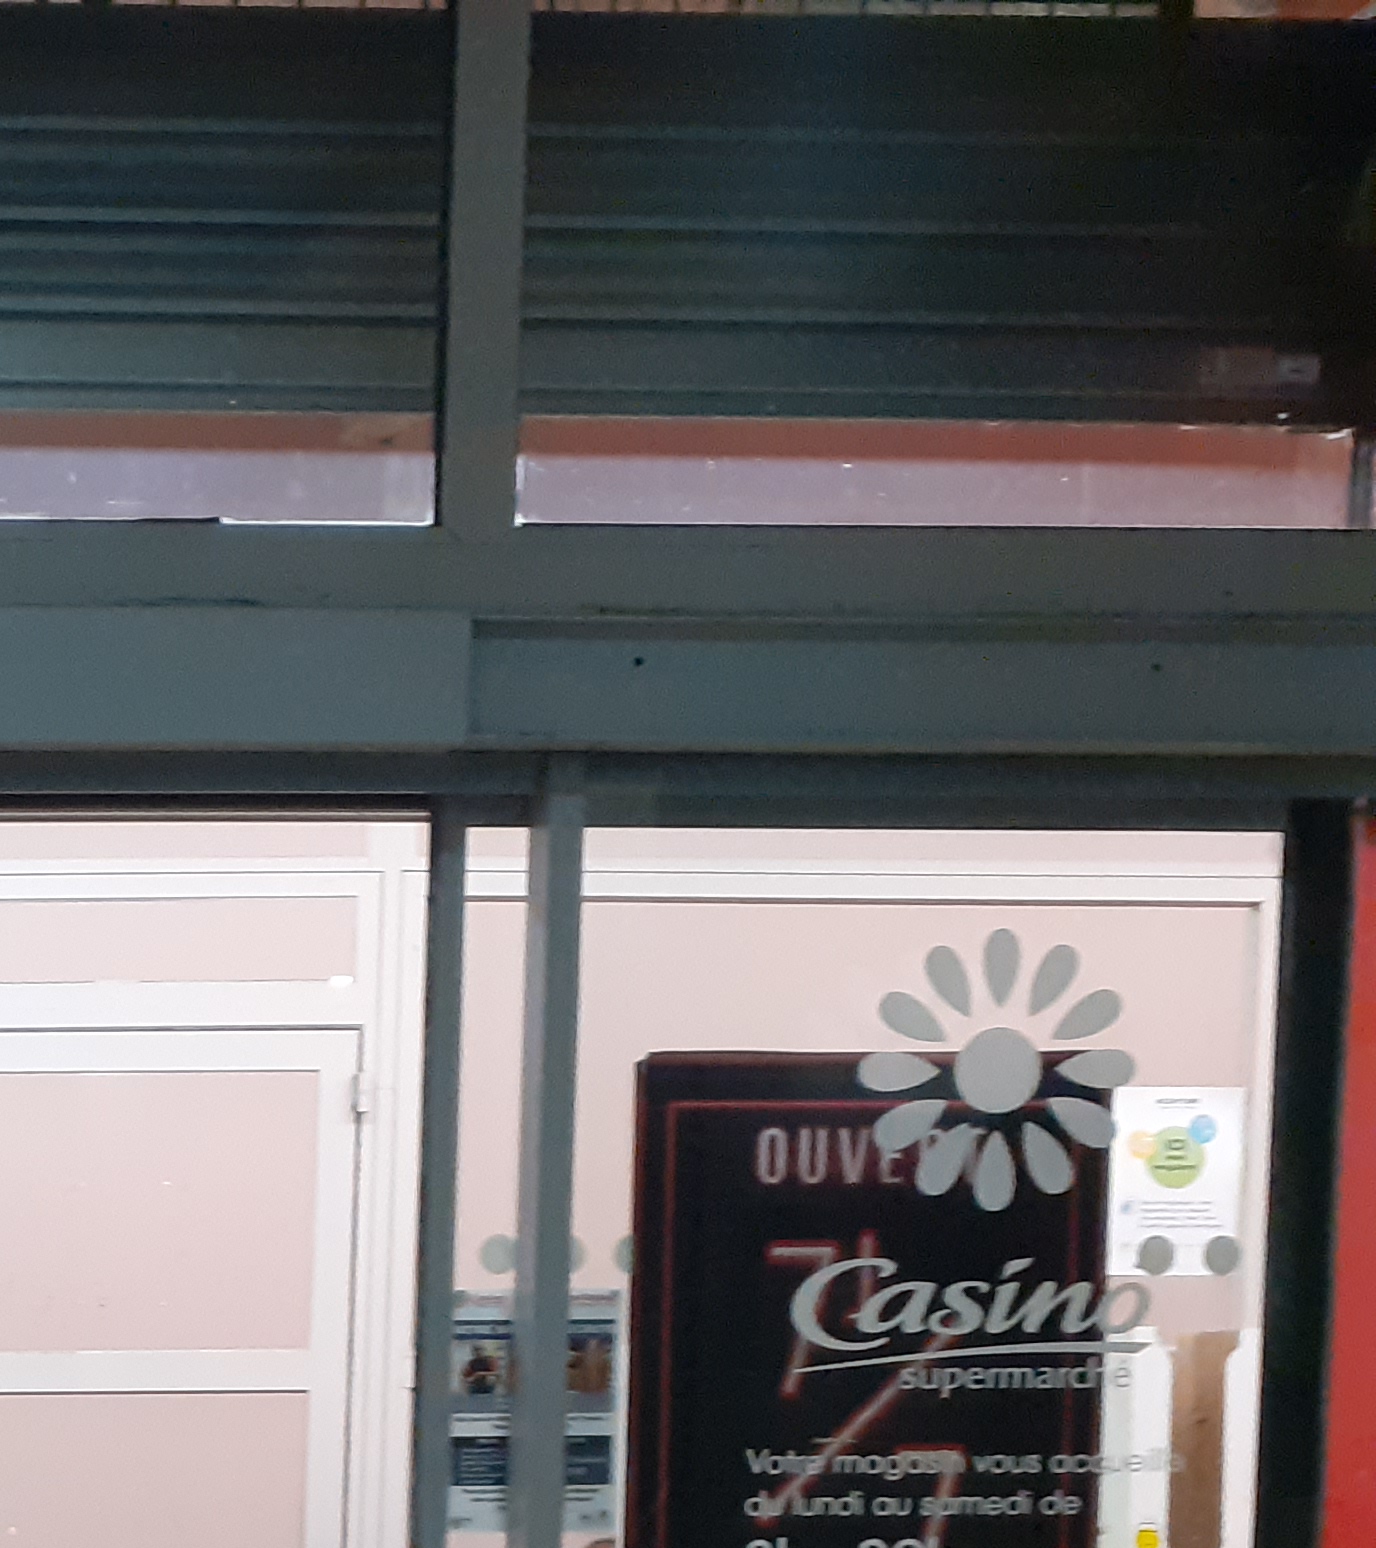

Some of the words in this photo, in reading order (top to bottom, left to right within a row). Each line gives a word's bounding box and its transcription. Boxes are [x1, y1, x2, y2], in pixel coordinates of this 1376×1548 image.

[757, 1126, 988, 1185] OUVE
[790, 1257, 1149, 1351] Casino
[899, 1355, 1133, 1398] supermarché
[973, 1453, 1042, 1474] vous
[871, 1496, 913, 1516] au
[918, 1490, 1034, 1516] samedi
[1039, 1490, 1083, 1516] de
